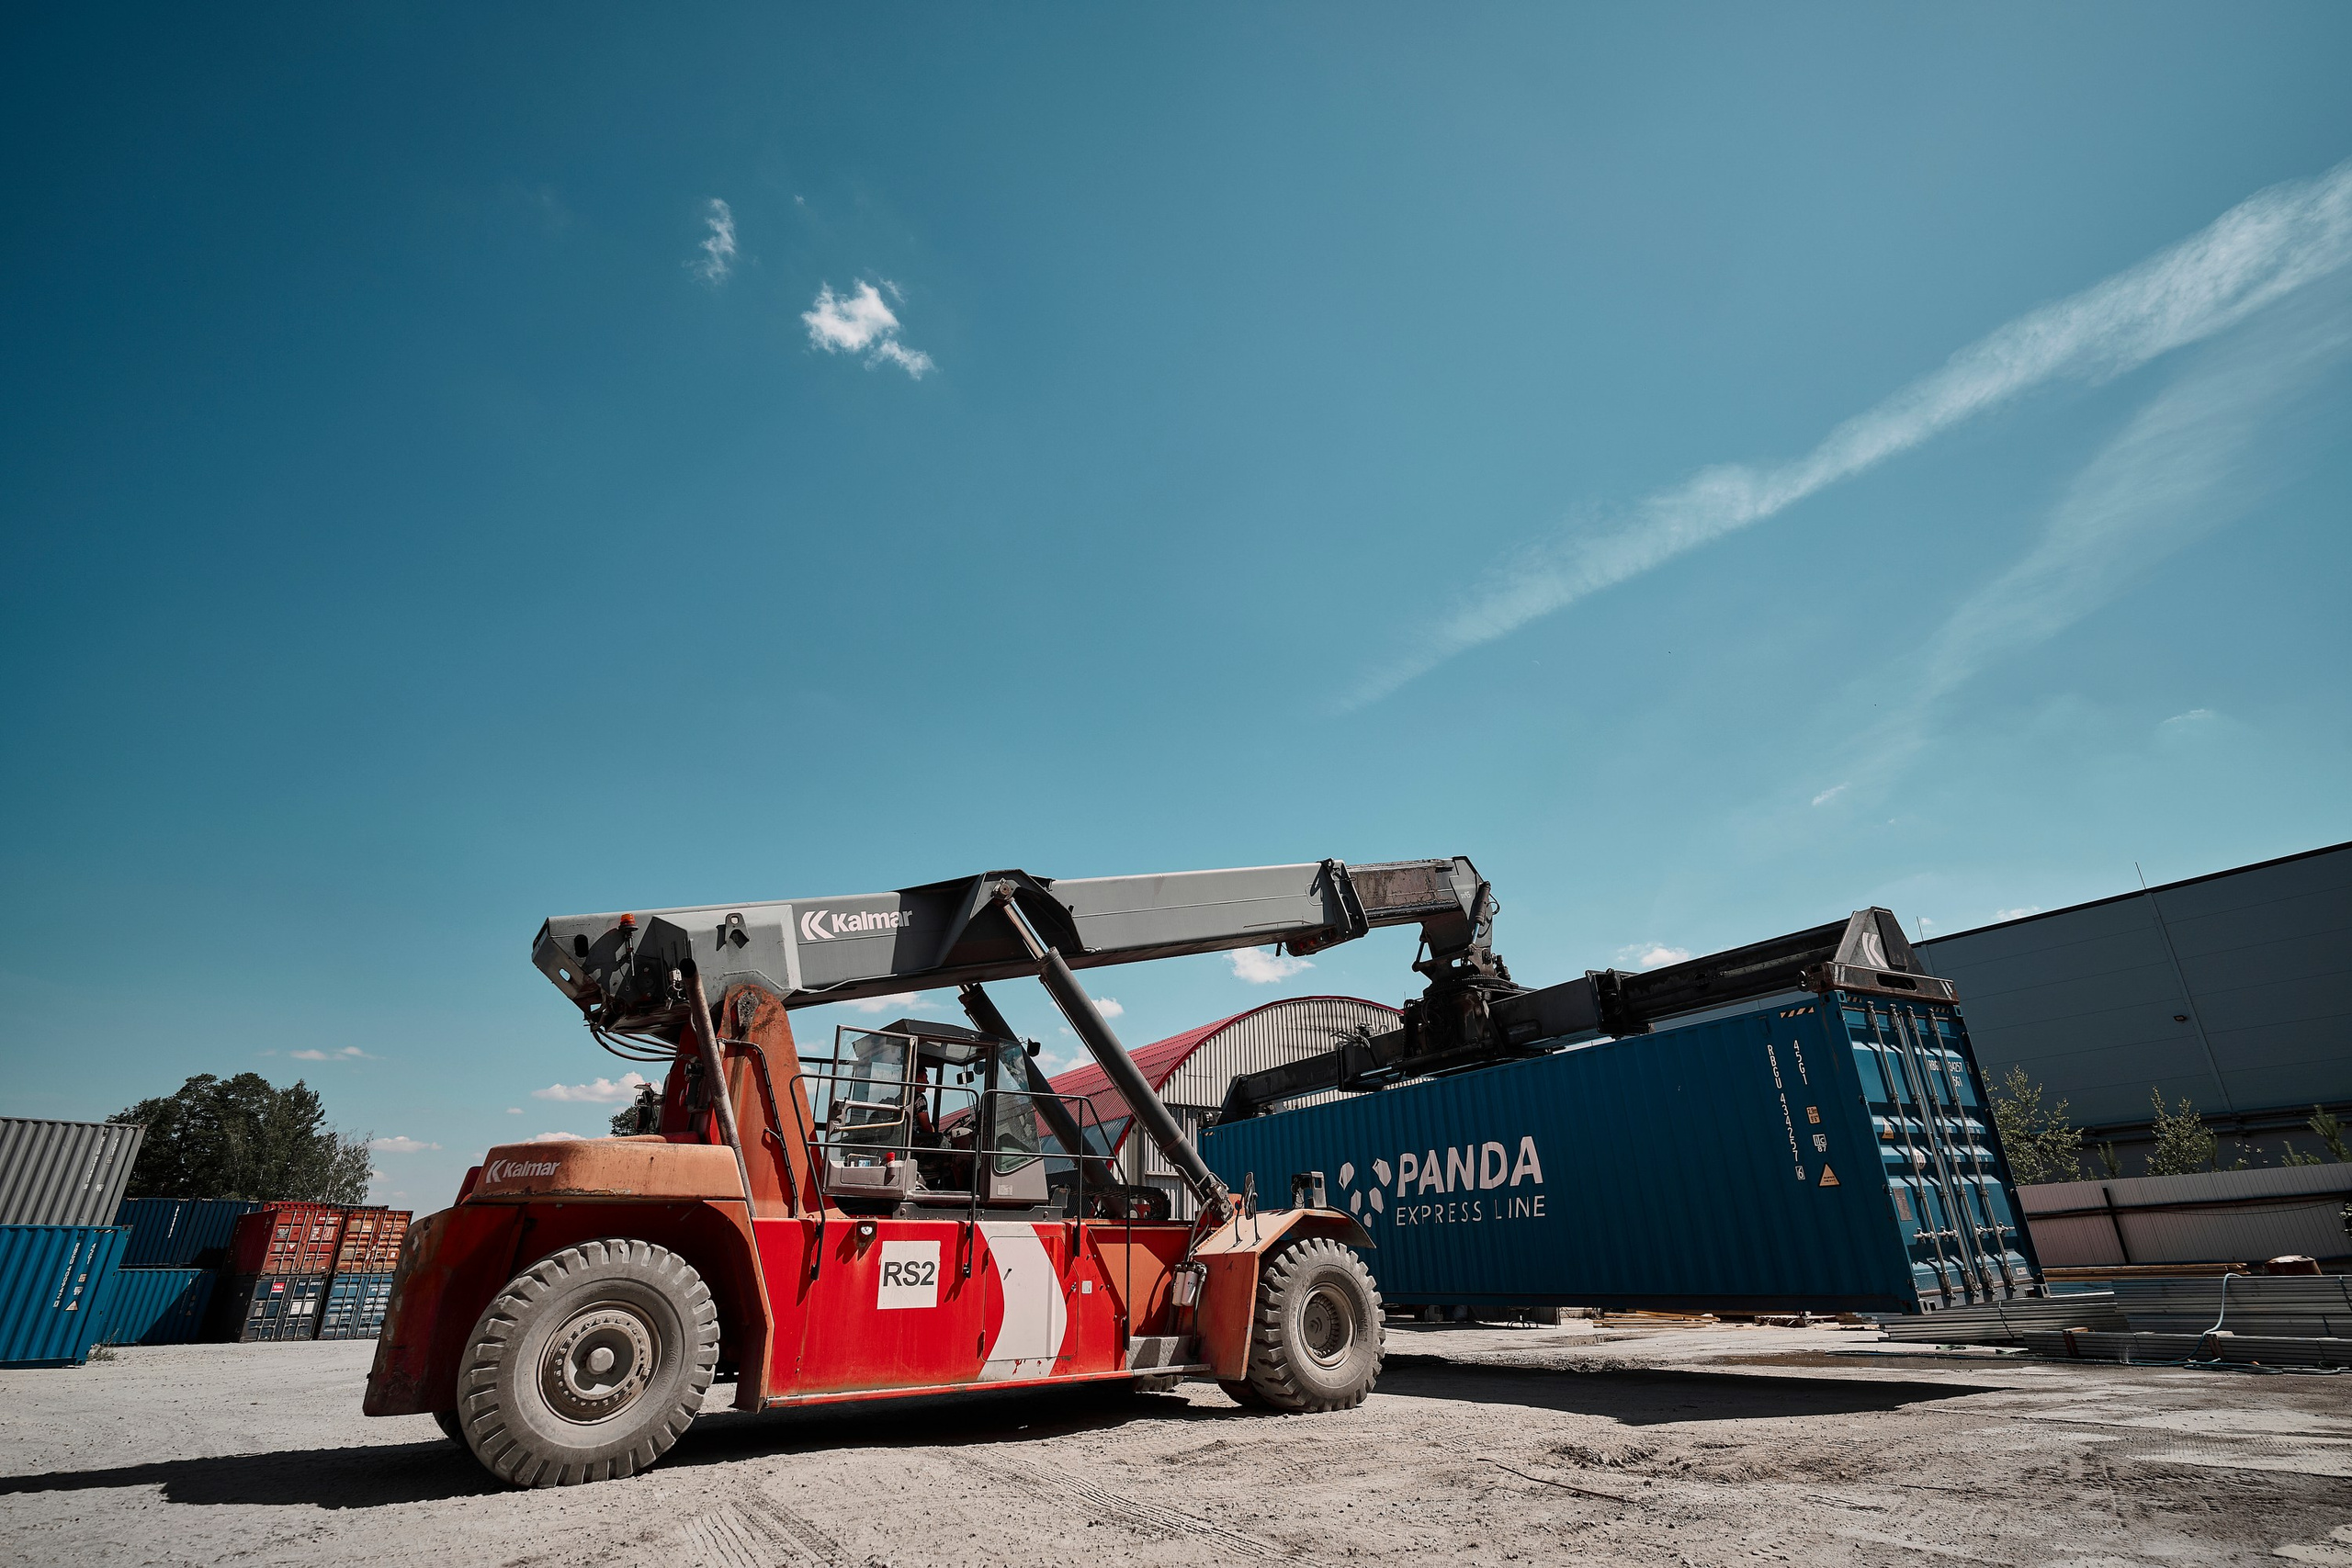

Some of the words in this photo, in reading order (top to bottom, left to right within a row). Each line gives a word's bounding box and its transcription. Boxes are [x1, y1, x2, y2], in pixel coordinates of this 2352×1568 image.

[831, 909, 912, 932] Kalmar
[1793, 1040, 1808, 1085] 45G1
[1767, 1044, 1782, 1089] RBGU
[1780, 1092, 1798, 1162] 434257
[502, 1160, 561, 1179] Kalmar
[1396, 1135, 1544, 1198] PANDA
[1396, 1200, 1482, 1226] EXPRESS
[1495, 1195, 1545, 1219] LINE
[883, 1261, 935, 1286] RS2
